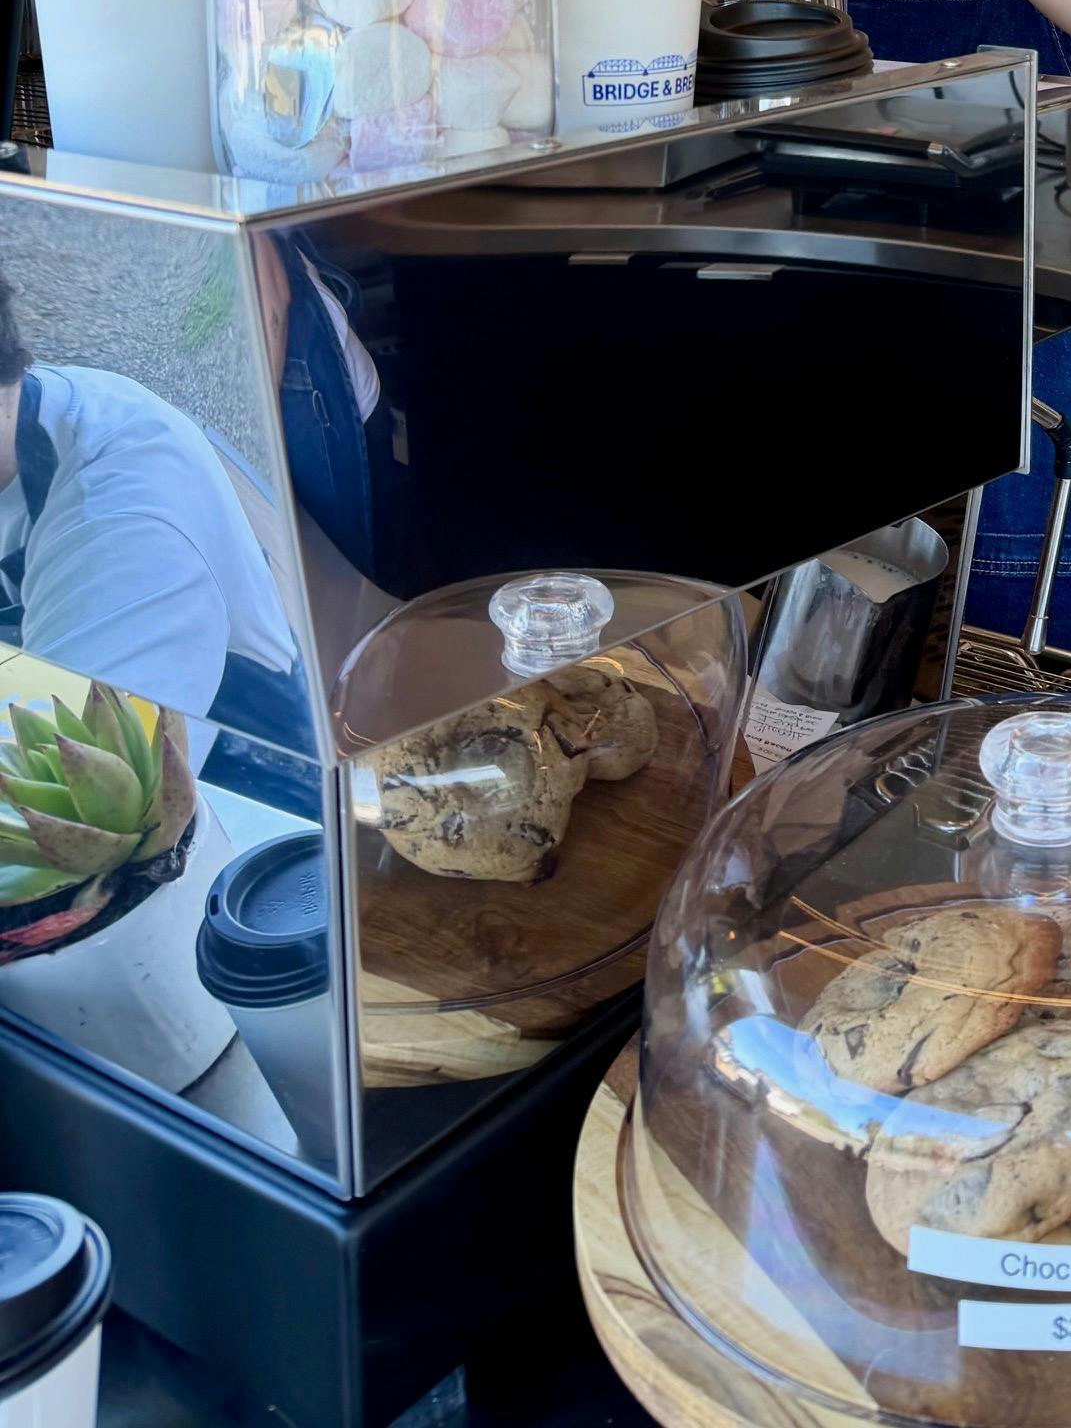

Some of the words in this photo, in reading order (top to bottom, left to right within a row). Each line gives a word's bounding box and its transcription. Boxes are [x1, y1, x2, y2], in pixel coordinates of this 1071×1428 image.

[592, 80, 660, 101] BRIDGE
[662, 79, 673, 96] &
[675, 73, 693, 94] BRE
[1001, 1253, 1071, 1281] Choc
